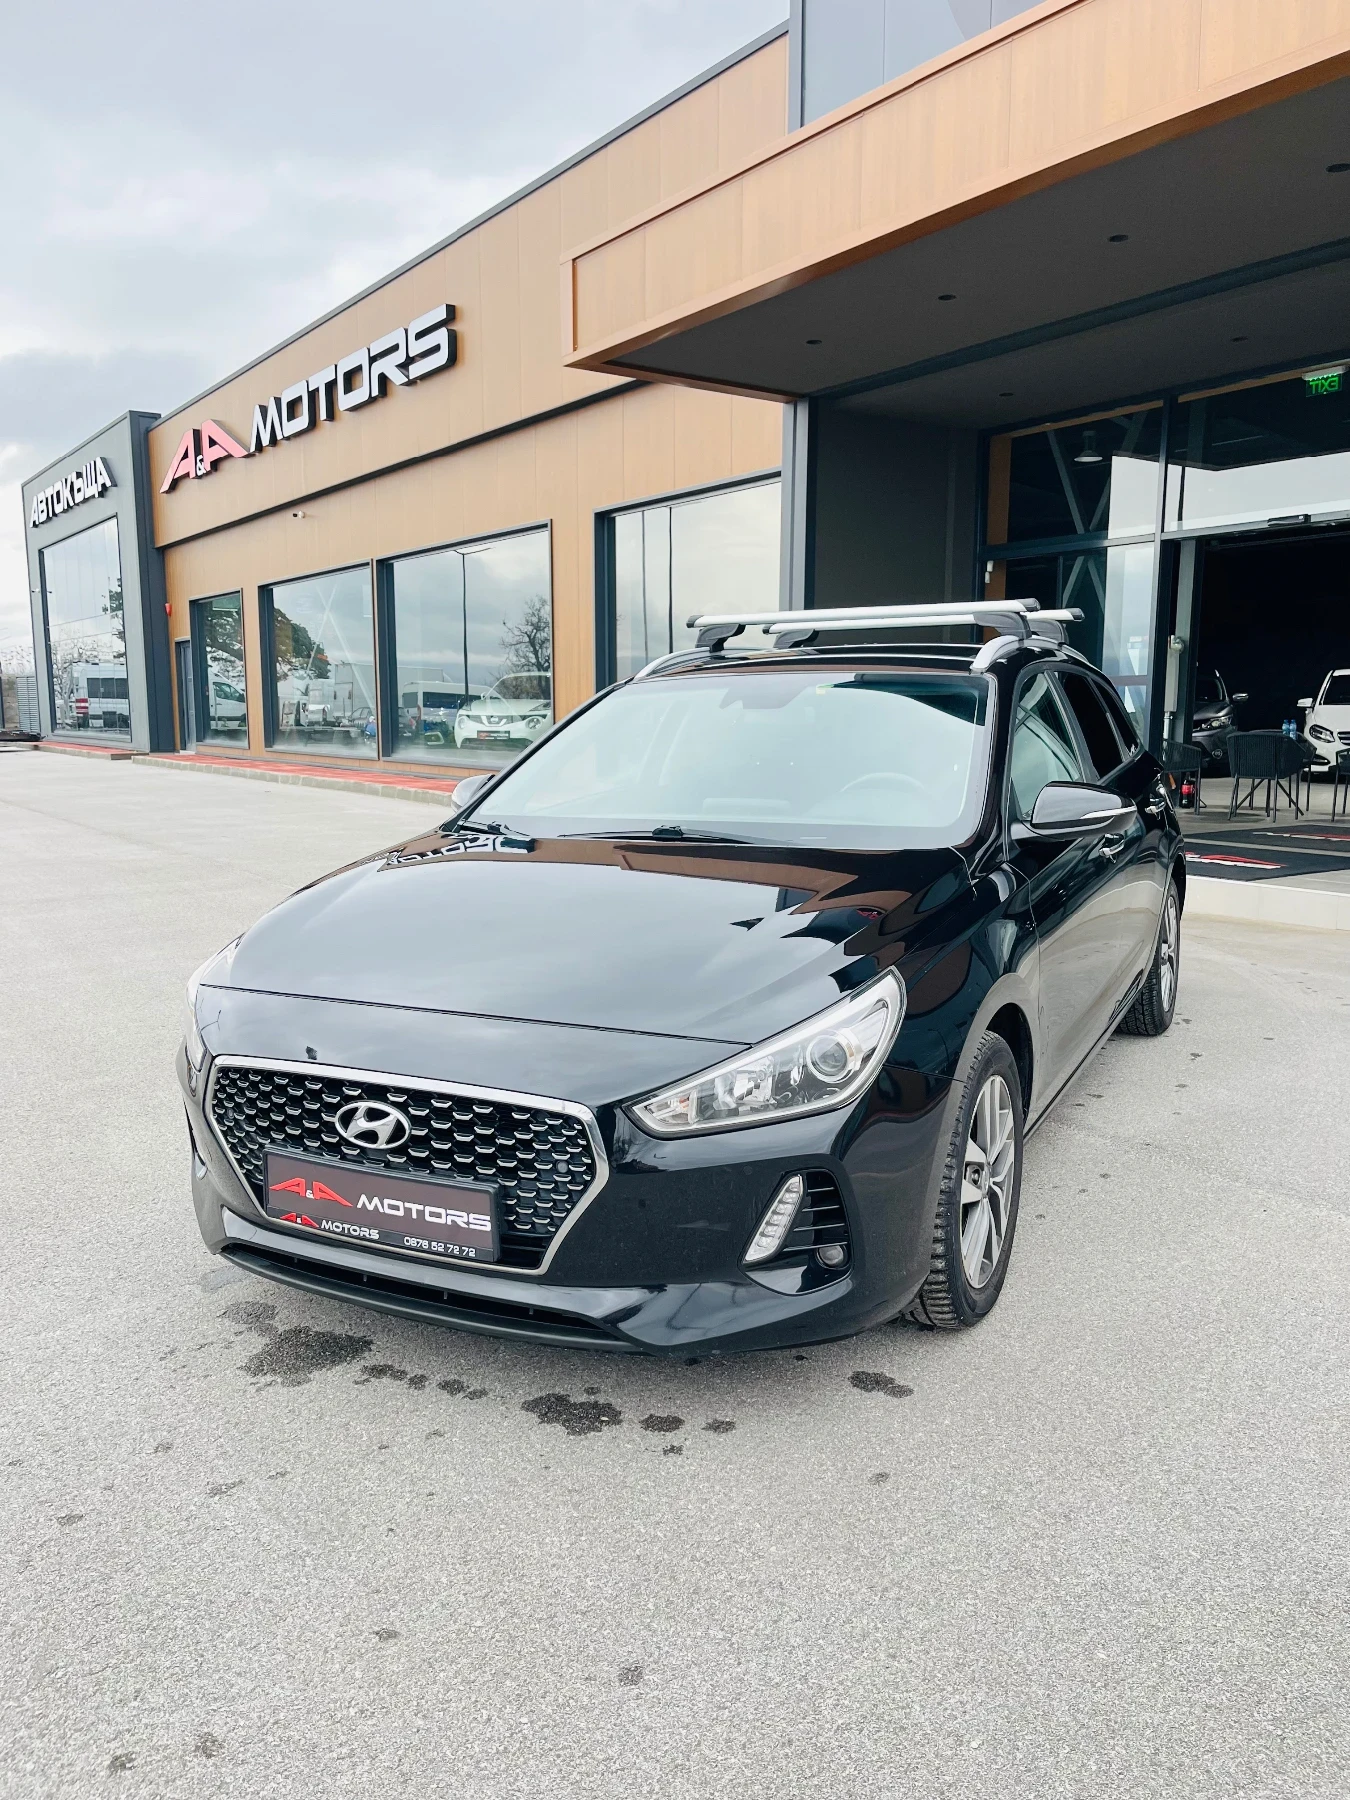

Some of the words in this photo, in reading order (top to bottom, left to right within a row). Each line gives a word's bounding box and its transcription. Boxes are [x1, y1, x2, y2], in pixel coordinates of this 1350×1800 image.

[160, 419, 251, 493] A&A
[251, 303, 453, 453] MOTORS
[30, 456, 114, 528] АВТОКЪЩА
[269, 1177, 353, 1207] A&A
[357, 1193, 492, 1232] MOTORS
[321, 1219, 380, 1240] MOTORS
[447, 1244, 460, 1255] 72
[462, 1247, 476, 1258] 72
